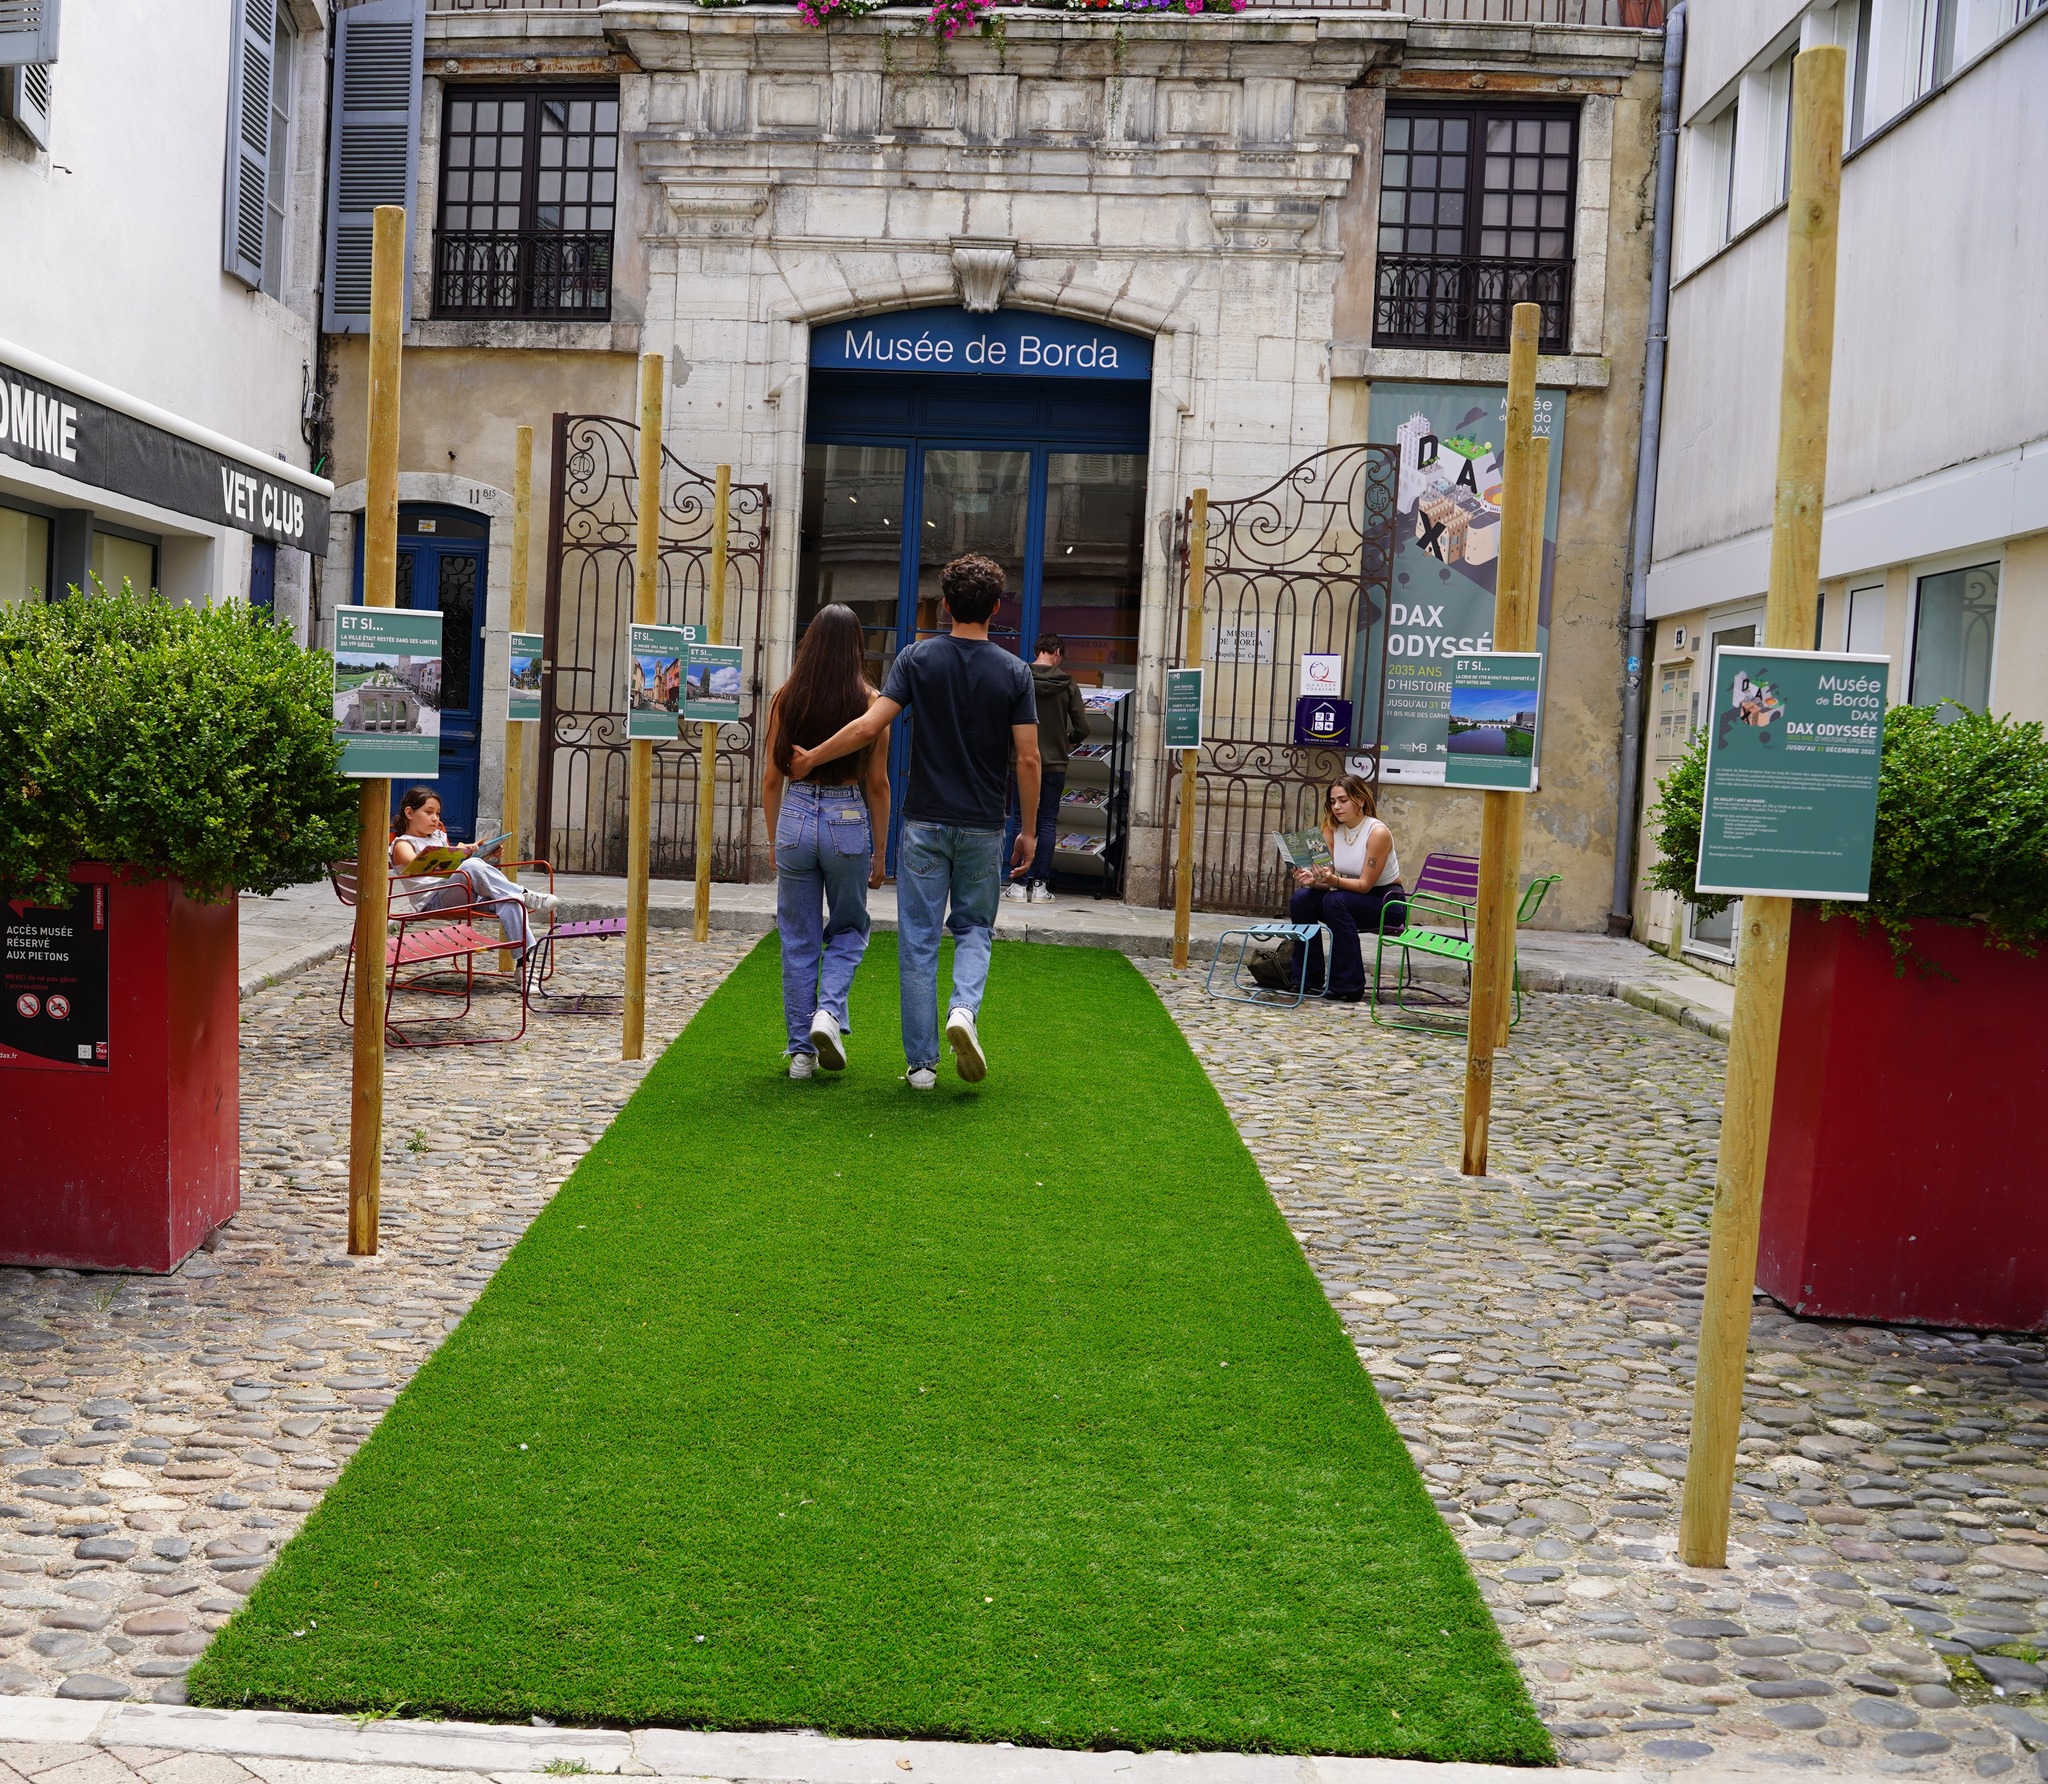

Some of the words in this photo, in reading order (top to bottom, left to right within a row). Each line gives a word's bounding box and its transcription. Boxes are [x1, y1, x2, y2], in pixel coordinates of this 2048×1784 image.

[845, 330, 953, 362] Musée
[965, 335, 1006, 364] de
[1019, 336, 1119, 368] Borda
[221, 466, 257, 522] VET
[261, 483, 304, 538] CLUB
[469, 489, 479, 503] 11
[483, 489, 496, 497] BIS
[1391, 603, 1444, 627] DAX
[342, 616, 357, 629] ET
[361, 618, 384, 631] SI...
[634, 632, 642, 640] ET
[1388, 632, 1492, 658] ODYSSÉ
[1389, 664, 1415, 676] 2035
[1417, 666, 1442, 677] ANS
[1457, 661, 1469, 670] ET
[1471, 661, 1490, 671] SI...
[1388, 679, 1452, 692] D'HISTOIRE
[1819, 675, 1881, 693] Musée
[1387, 699, 1428, 709] JUSQU'AU
[1429, 701, 1438, 709] 31
[1816, 697, 1829, 706] de
[1833, 693, 1879, 708] Borda
[1852, 710, 1878, 721] DAX
[1787, 722, 1814, 735] DAX
[1817, 723, 1877, 738] ODYSSÉE
[1826, 746, 1859, 754] DÉCEMBRE
[6, 924, 37, 935] ACCÈS
[40, 926, 73, 937] MUSÉE
[6, 936, 50, 948] RÉSERVÉ
[6, 951, 26, 960] AUX
[28, 952, 69, 961] PIETONS
